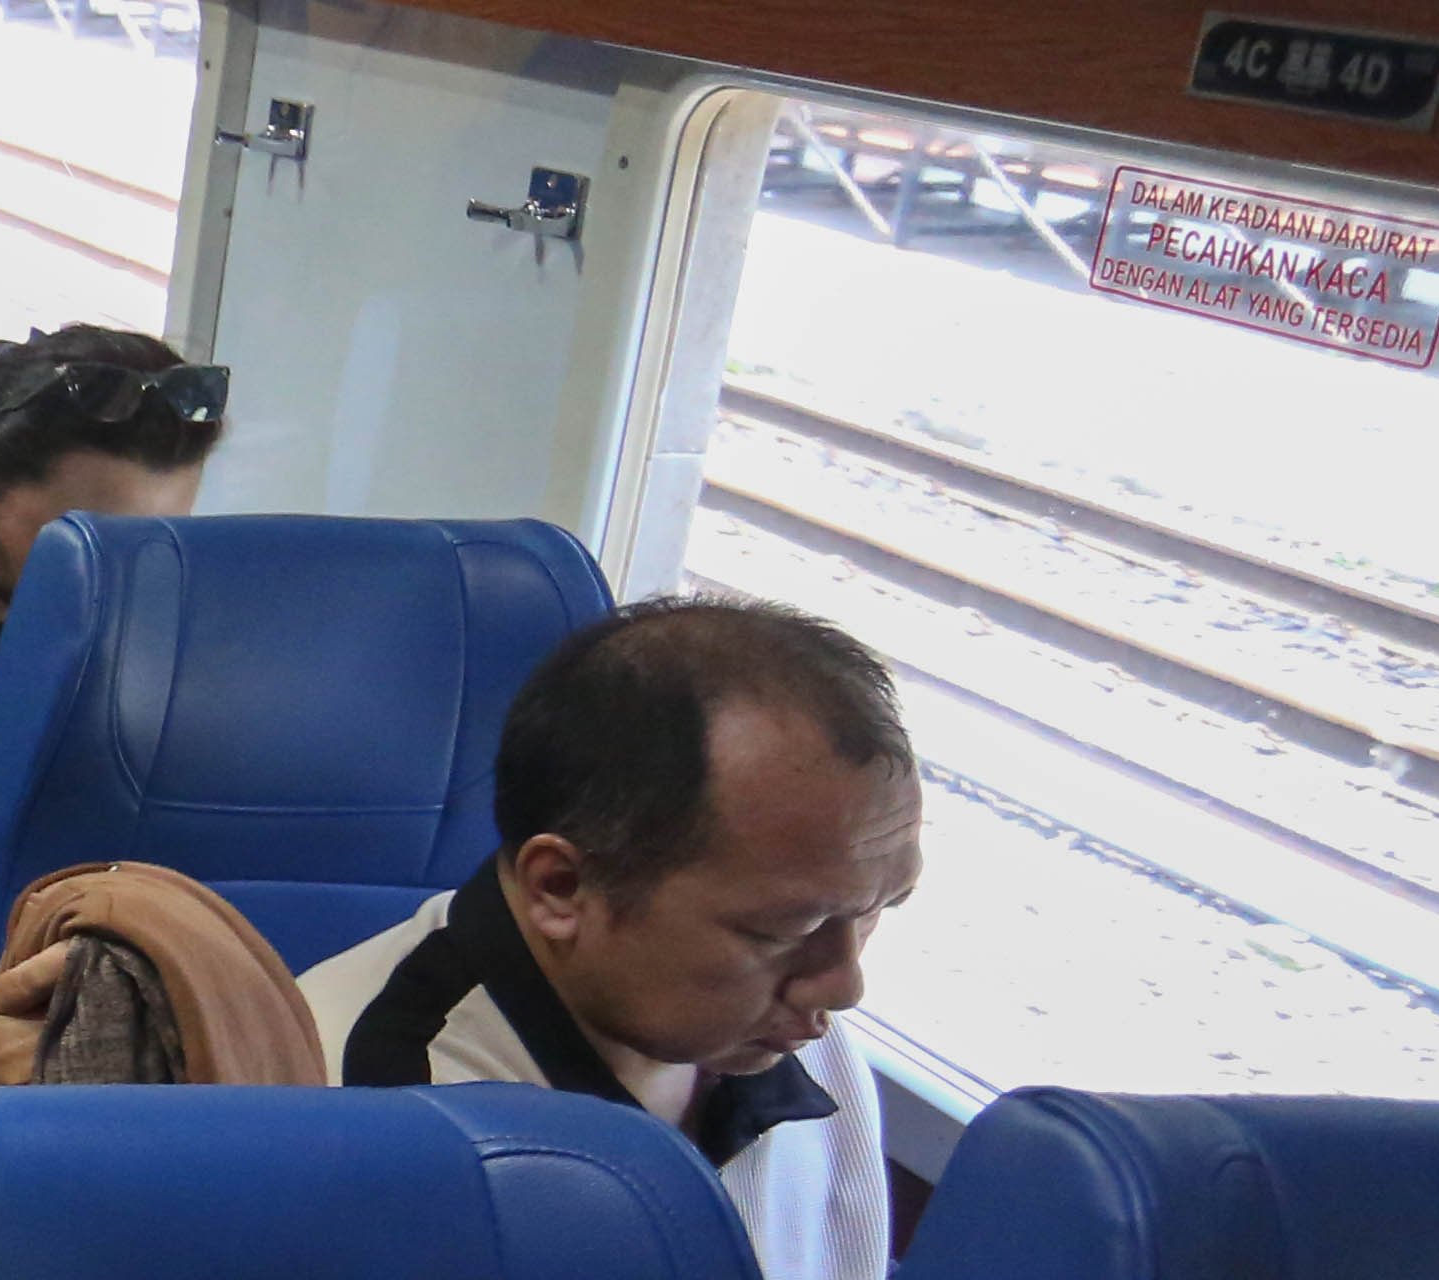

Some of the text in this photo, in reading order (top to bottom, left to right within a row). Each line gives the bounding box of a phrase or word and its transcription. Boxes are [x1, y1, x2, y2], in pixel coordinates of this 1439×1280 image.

[1223, 35, 1390, 95] 4C 4D
[1129, 181, 1435, 263] DALAM KEADAAN DARURAT
[1145, 222, 1388, 304] PECAHKAN KACA
[1100, 257, 1423, 356] DENGAN ALAT YANG TERSEDIA
